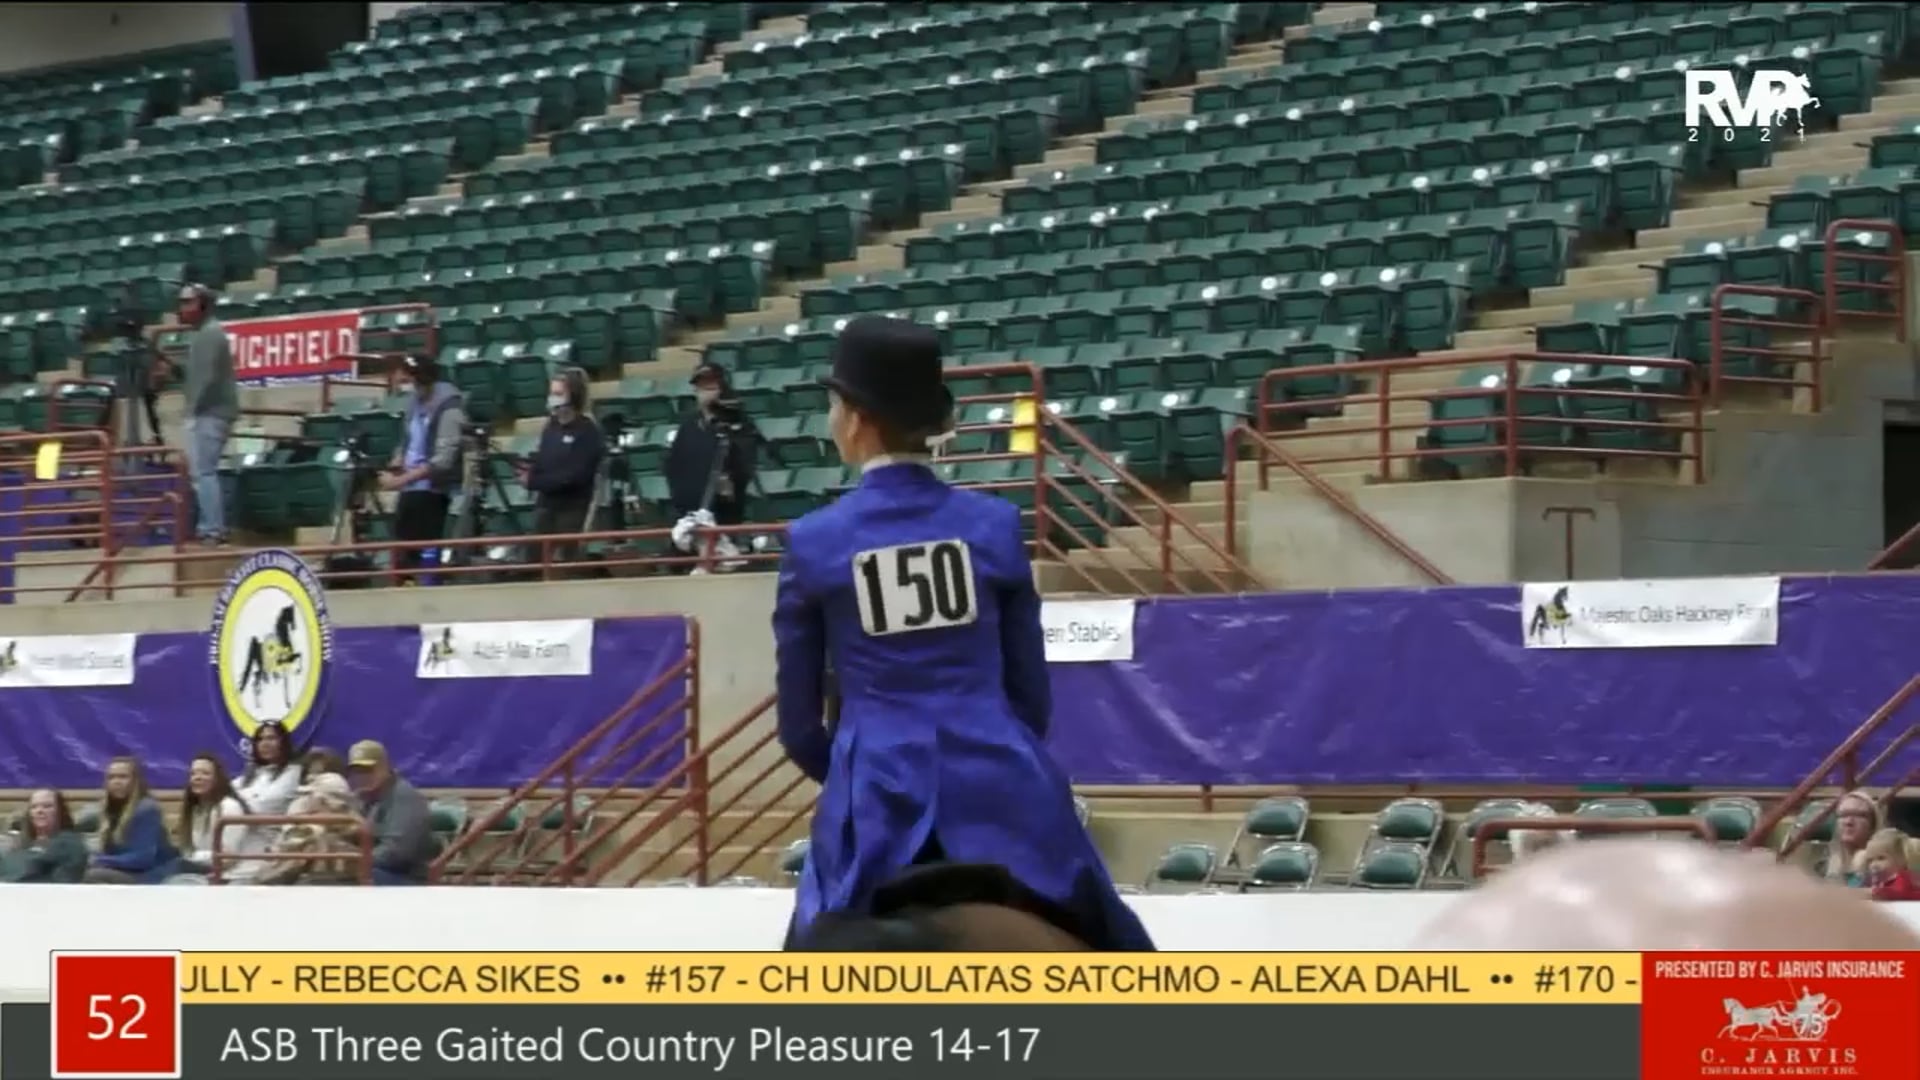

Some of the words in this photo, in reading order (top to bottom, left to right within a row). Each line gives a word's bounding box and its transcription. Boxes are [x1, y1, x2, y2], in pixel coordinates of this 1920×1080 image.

[862, 543, 969, 632] 150
[1639, 605, 1673, 624] Oaks
[1676, 604, 1733, 626] Hackney
[1068, 621, 1121, 643] Stables
